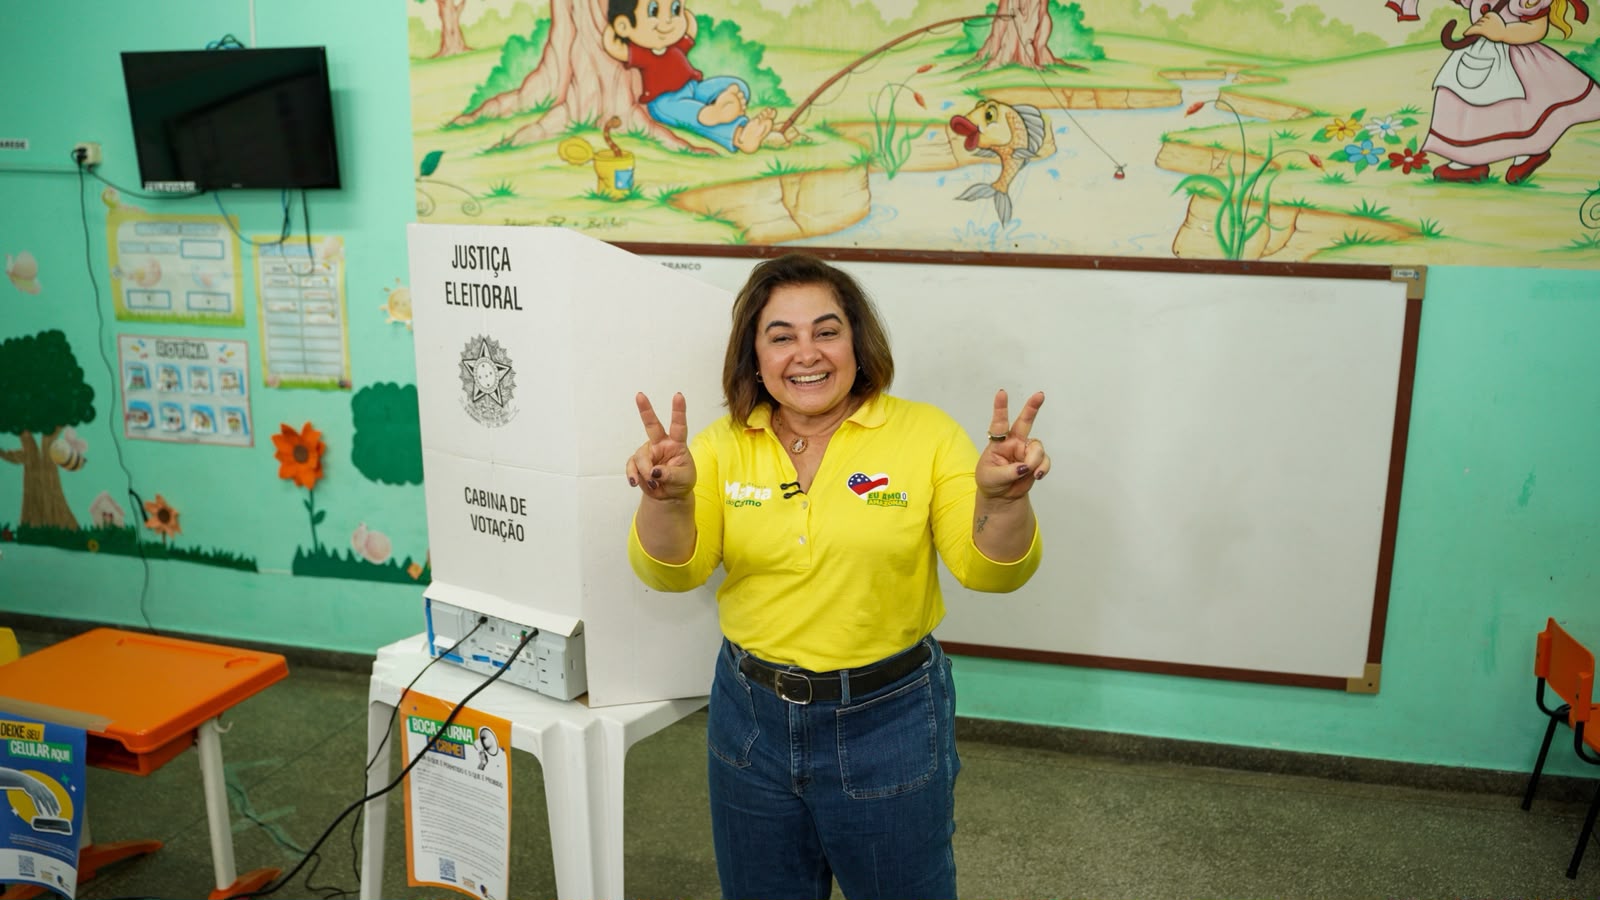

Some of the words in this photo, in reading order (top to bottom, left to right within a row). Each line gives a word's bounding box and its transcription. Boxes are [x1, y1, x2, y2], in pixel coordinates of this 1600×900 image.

[452, 244, 512, 278] JUSTIÇA
[445, 281, 523, 311] ELEITORAL
[464, 486, 508, 513] CABINA
[510, 496, 527, 516] DE
[882, 492, 901, 500] AMO
[470, 513, 525, 543] VOTAÇÃO
[1, 722, 25, 739] DEIXE
[27, 729, 41, 740] SEU
[412, 717, 437, 736] BOCA
[447, 725, 473, 743] URNA
[10, 740, 50, 759] CELULAR
